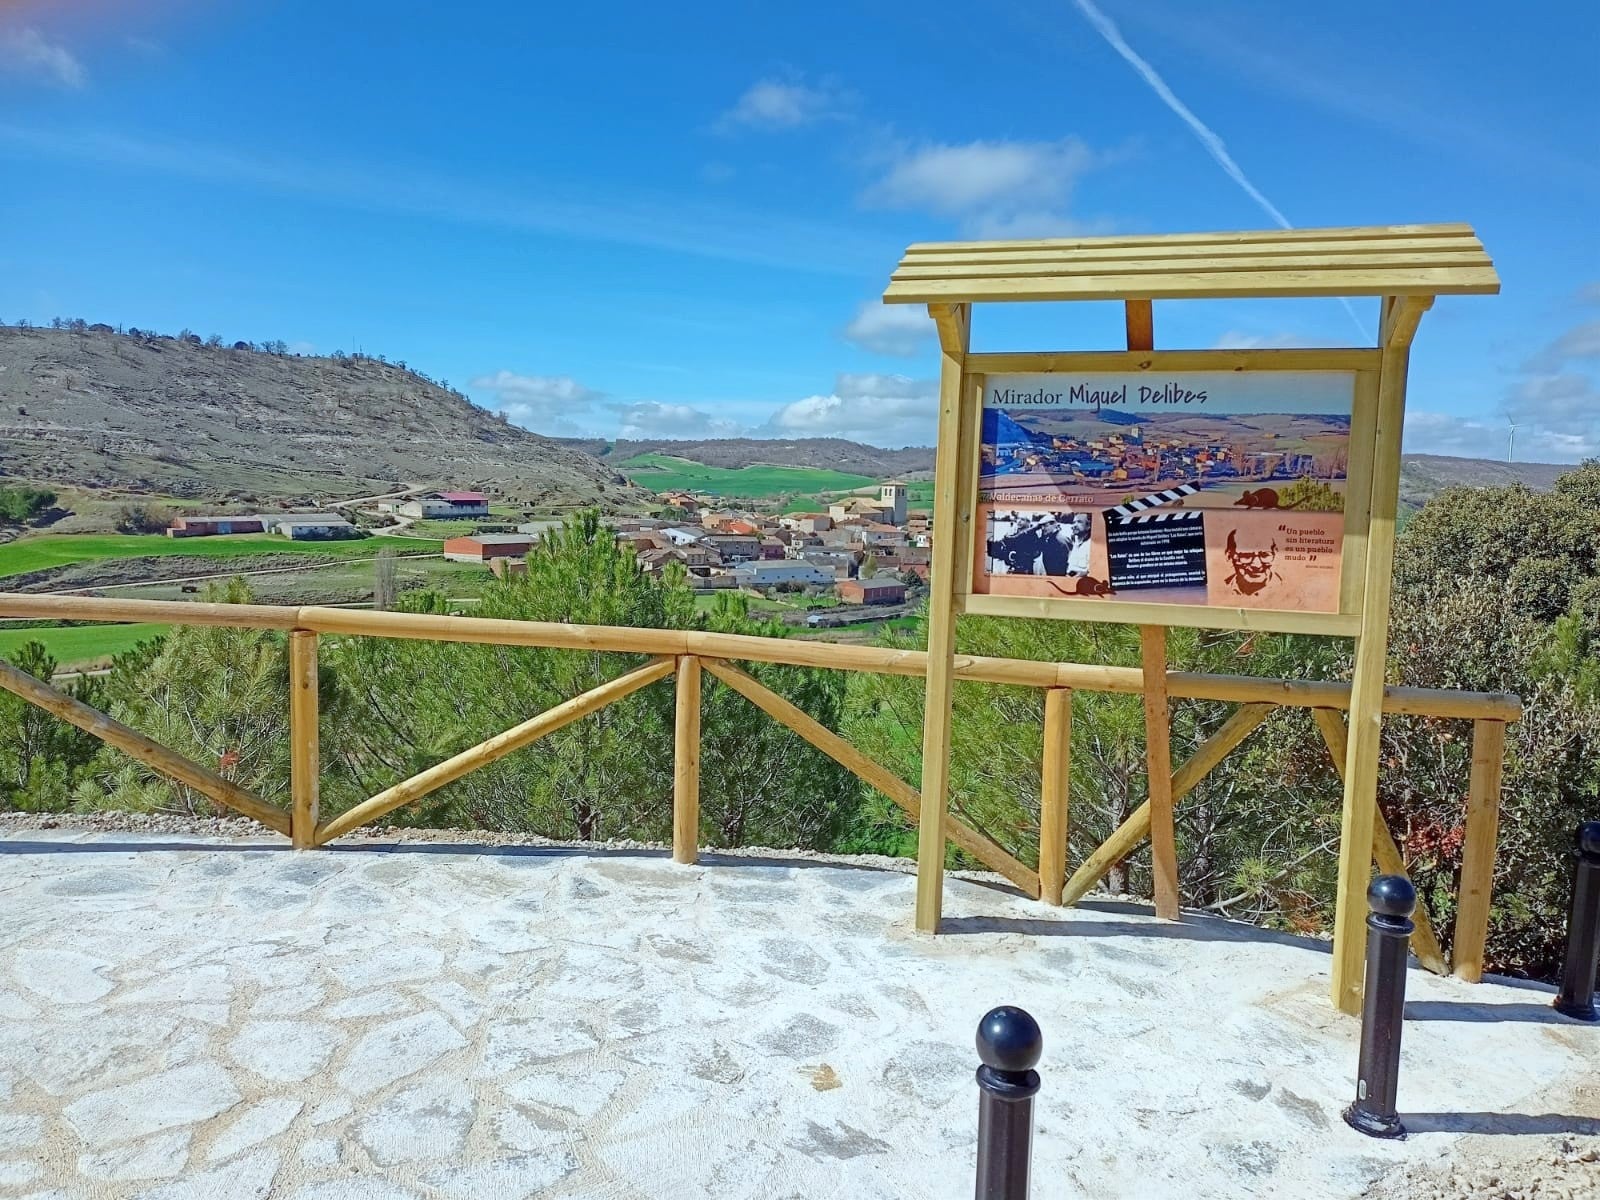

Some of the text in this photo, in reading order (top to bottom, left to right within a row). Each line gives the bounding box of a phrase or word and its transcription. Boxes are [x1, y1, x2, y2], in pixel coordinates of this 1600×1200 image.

[991, 382, 1208, 414] Mirador Miguel Delibes
[1299, 528, 1325, 536] pueblo
